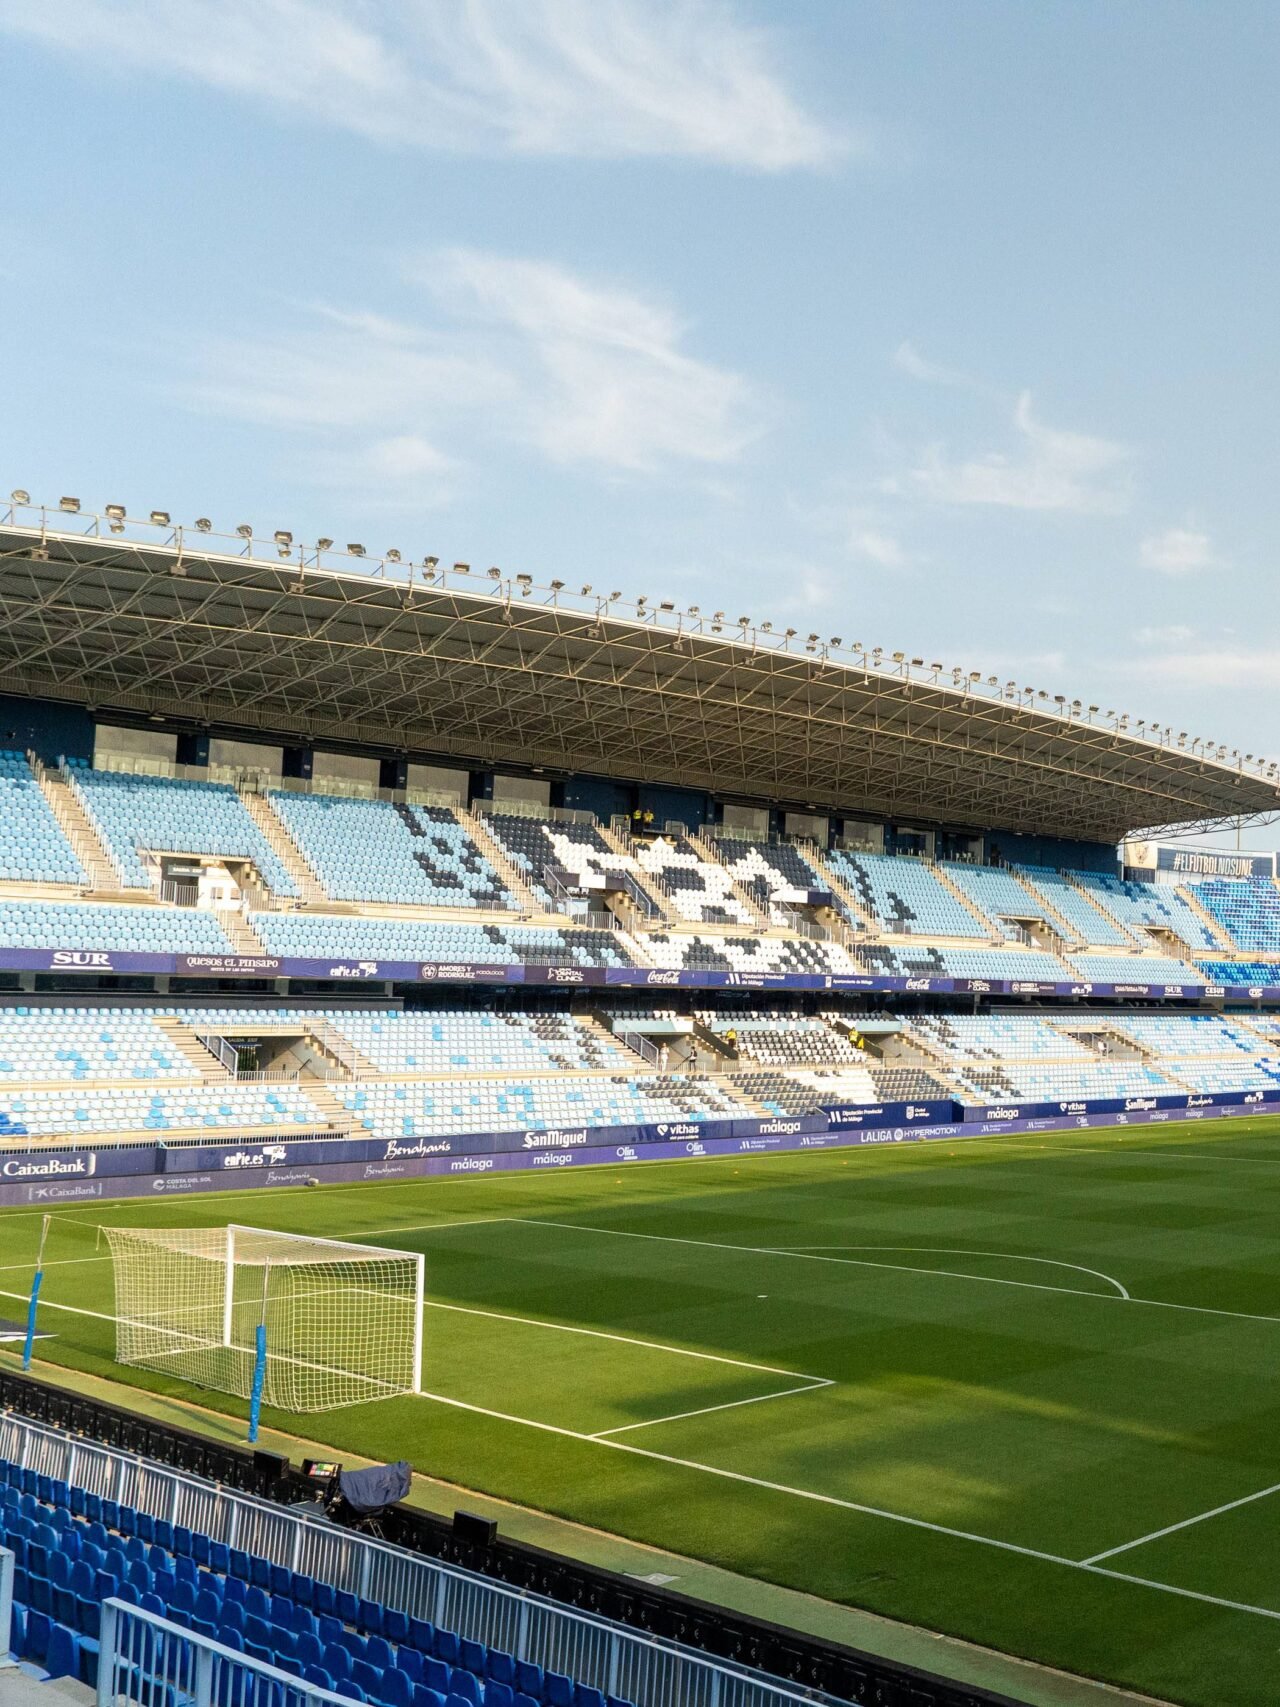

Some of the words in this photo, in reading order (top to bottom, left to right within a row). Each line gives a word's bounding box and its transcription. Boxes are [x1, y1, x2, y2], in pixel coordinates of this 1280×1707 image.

[53, 951, 111, 965] SUR
[1164, 986, 1183, 994] SUR
[1067, 1102, 1087, 1110] vithas
[669, 1125, 700, 1135] vithas
[860, 1130, 893, 1143] LALIGA
[904, 1126, 957, 1138] HYPERMOTION
[522, 1130, 587, 1149] SanMiguel
[224, 1152, 263, 1167] enPie.es
[3, 1158, 86, 1177] CaixaBank
[49, 1185, 97, 1197] CaixaBank
